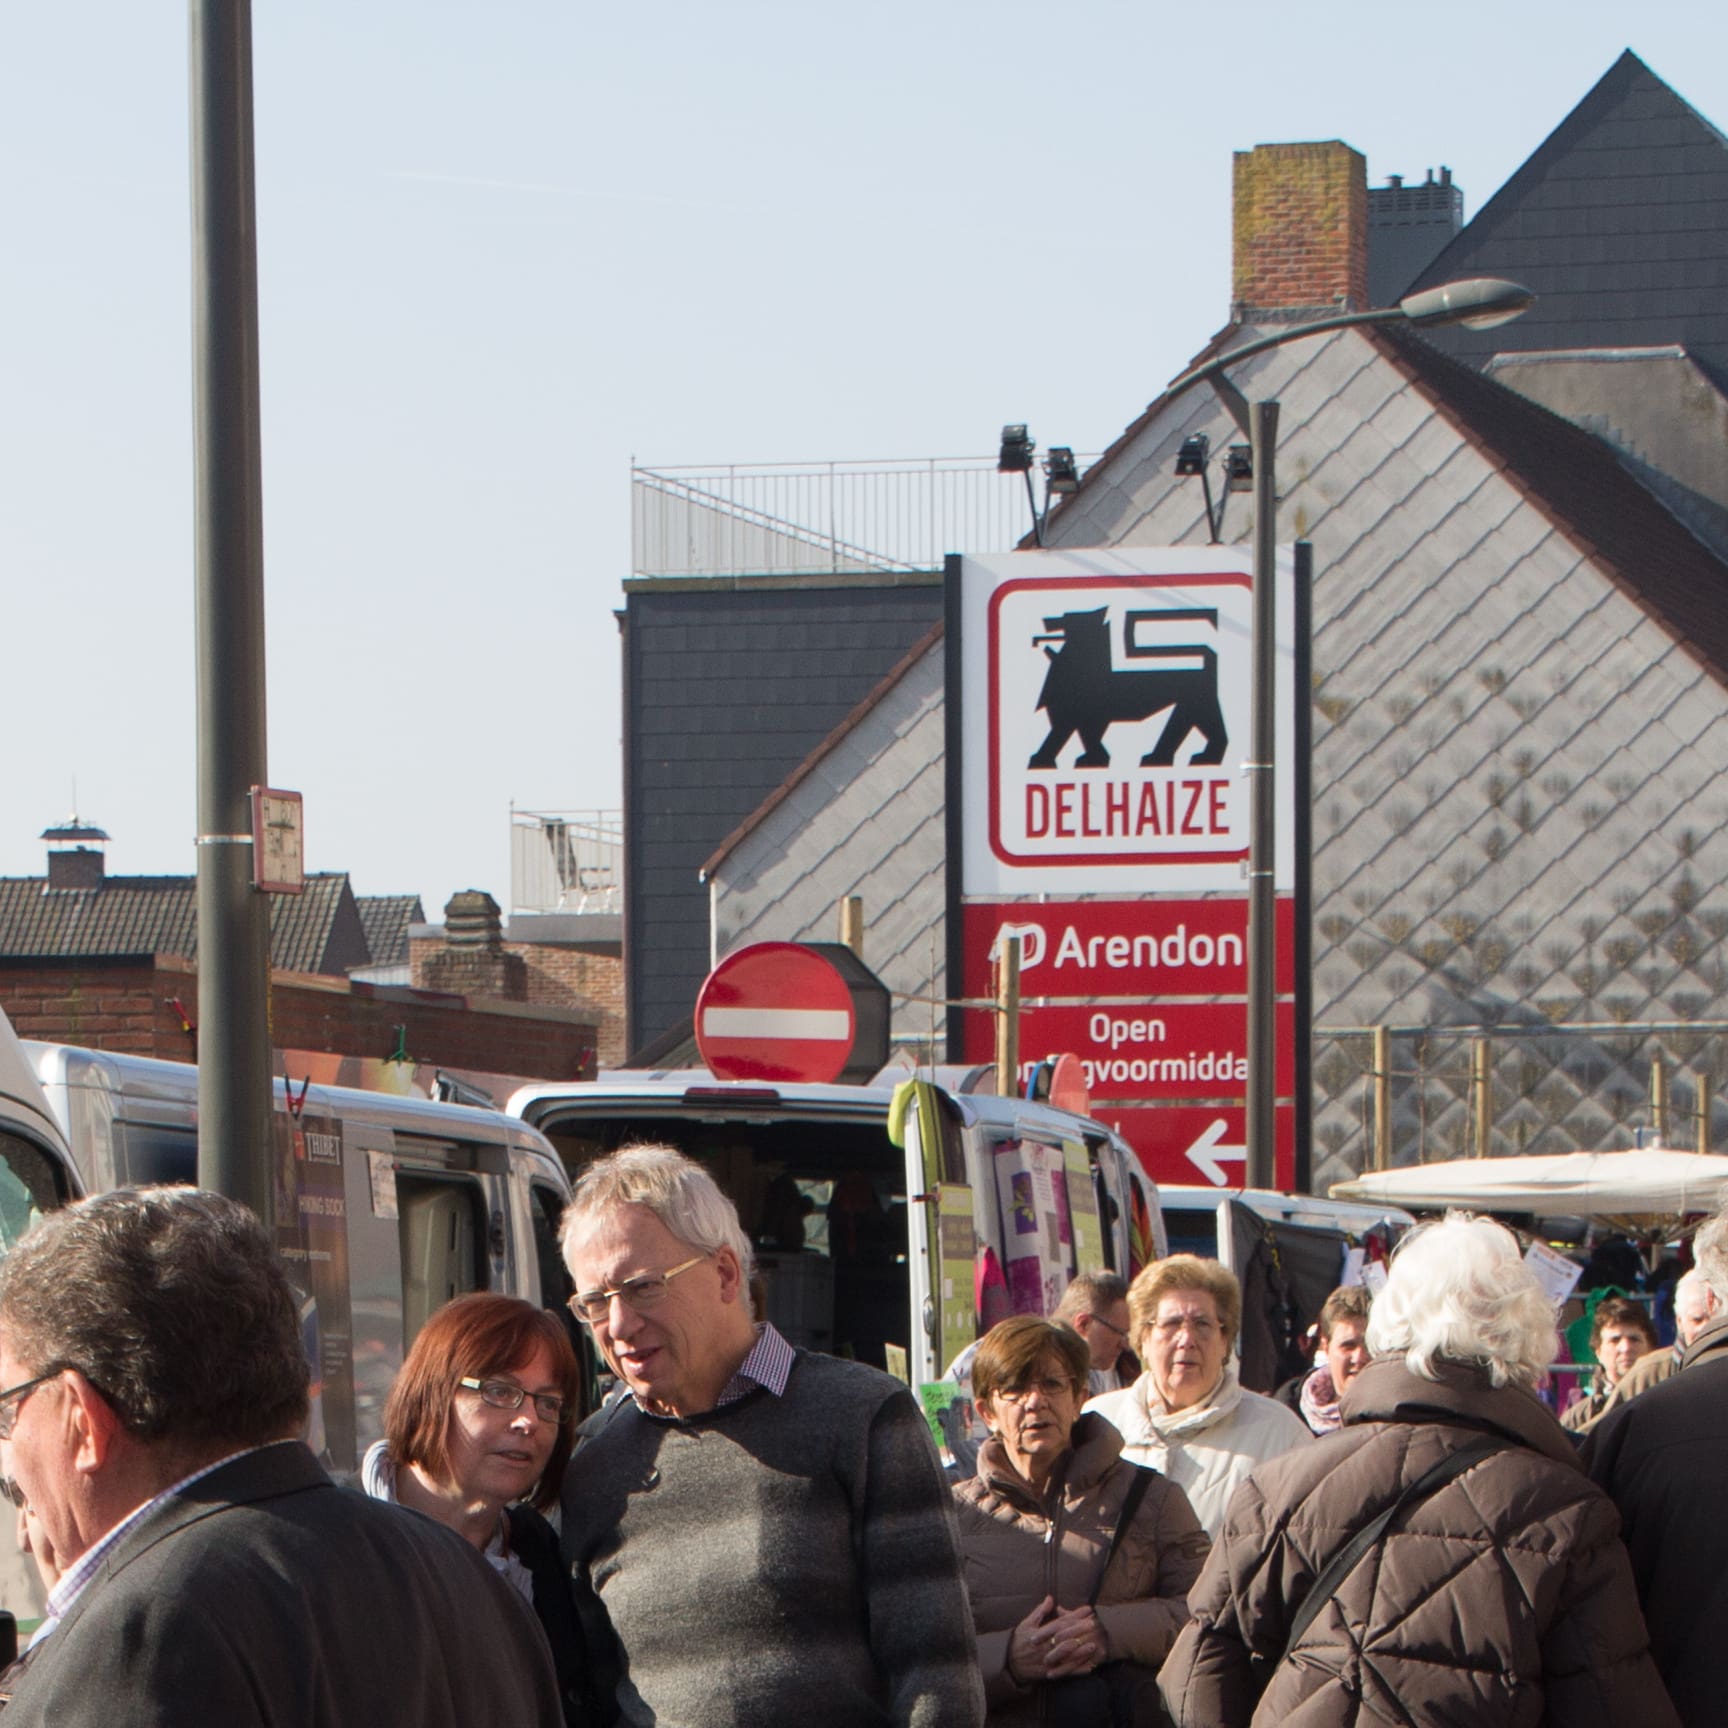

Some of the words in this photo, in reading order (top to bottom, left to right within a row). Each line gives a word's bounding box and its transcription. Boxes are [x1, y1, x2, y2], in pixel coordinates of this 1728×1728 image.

[1025, 779, 1230, 838] DELHAIZE
[1054, 924, 1248, 969] Arendon
[1089, 1012, 1166, 1050] Open
